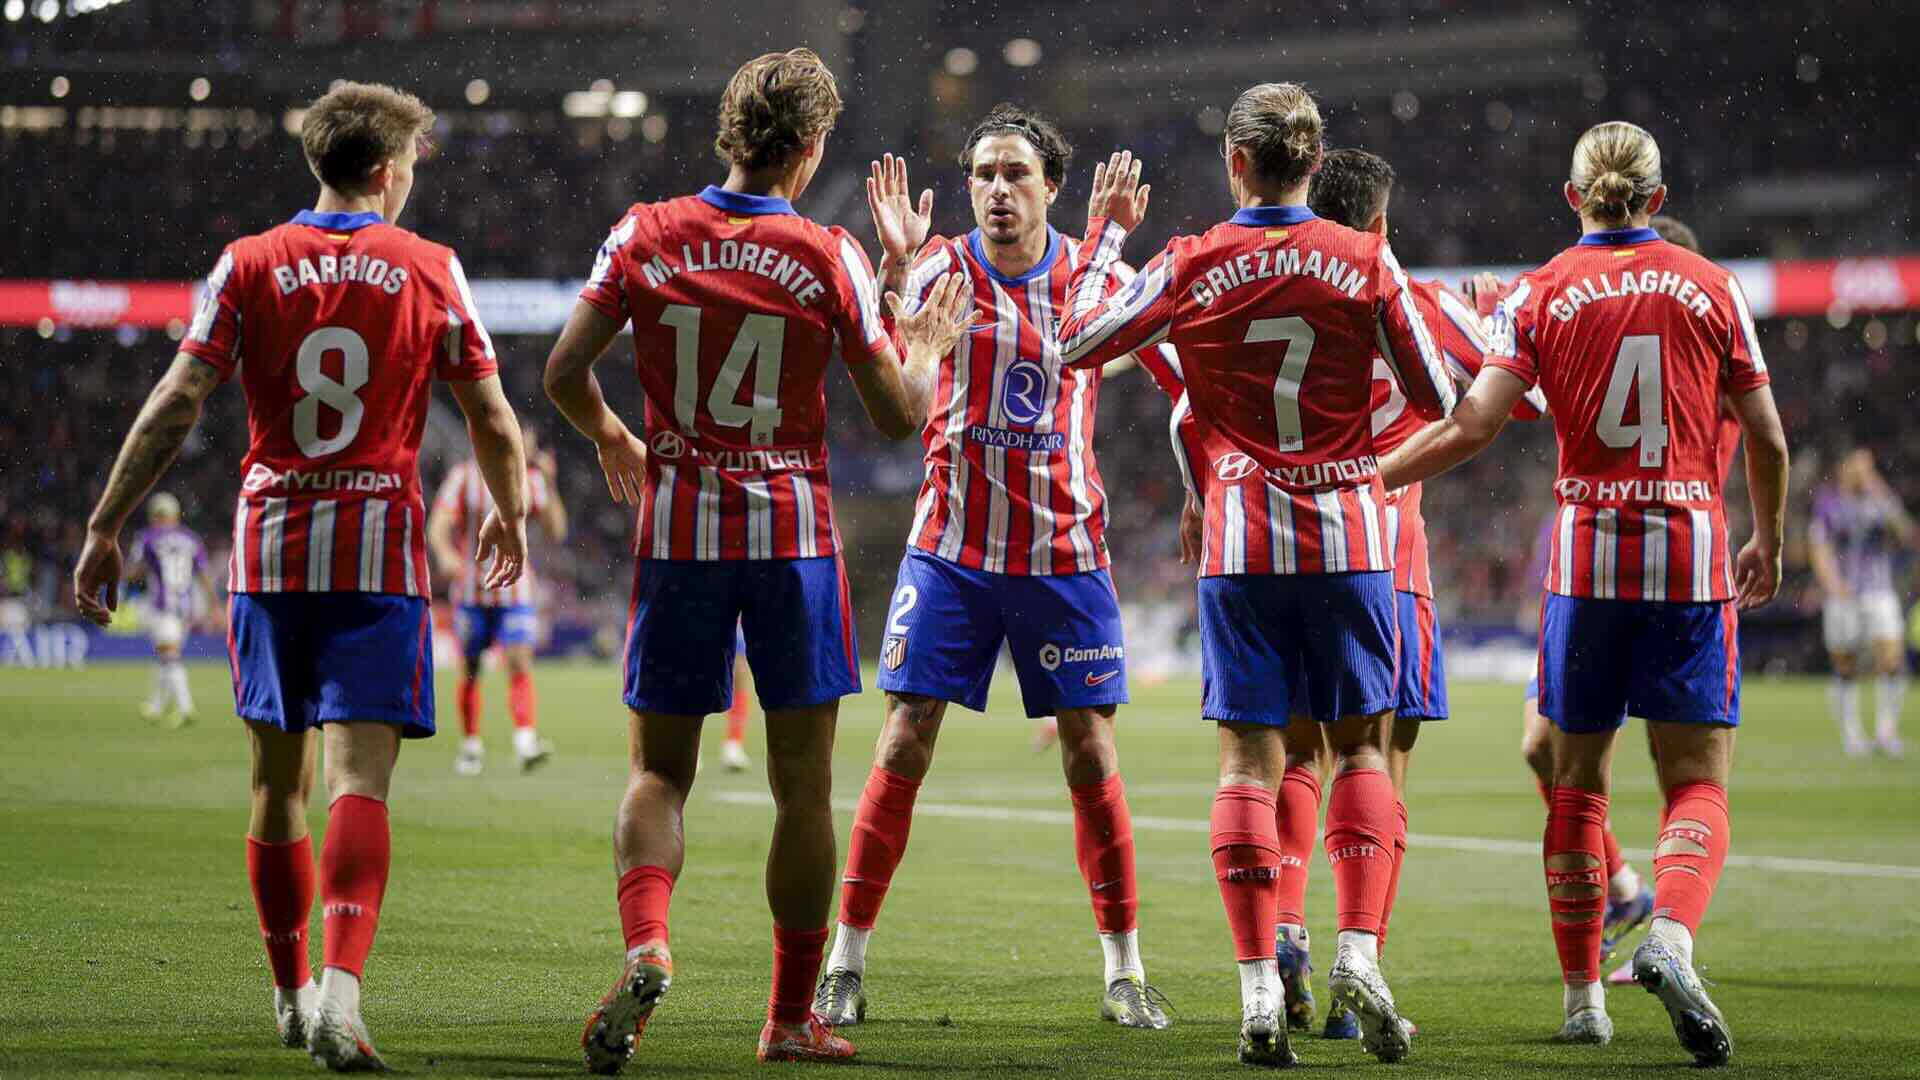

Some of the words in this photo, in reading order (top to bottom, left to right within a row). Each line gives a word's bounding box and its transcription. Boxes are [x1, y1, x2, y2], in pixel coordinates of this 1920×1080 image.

[273, 254, 408, 295] BARRIOS
[641, 254, 681, 289] M.
[682, 240, 825, 307] LLORENTE
[1191, 248, 1367, 307] GRIEZMANN
[1549, 269, 1712, 322] GALLAGHER
[293, 326, 369, 458] 8
[658, 303, 787, 447] 14
[1243, 315, 1316, 452] 7
[1596, 334, 1668, 467] 4
[691, 447, 813, 472] YUNDAI
[972, 425, 1033, 449] RIYADH
[1036, 432, 1065, 450] AIR
[1597, 480, 1712, 501] HYUNDAI
[890, 584, 917, 636] 2
